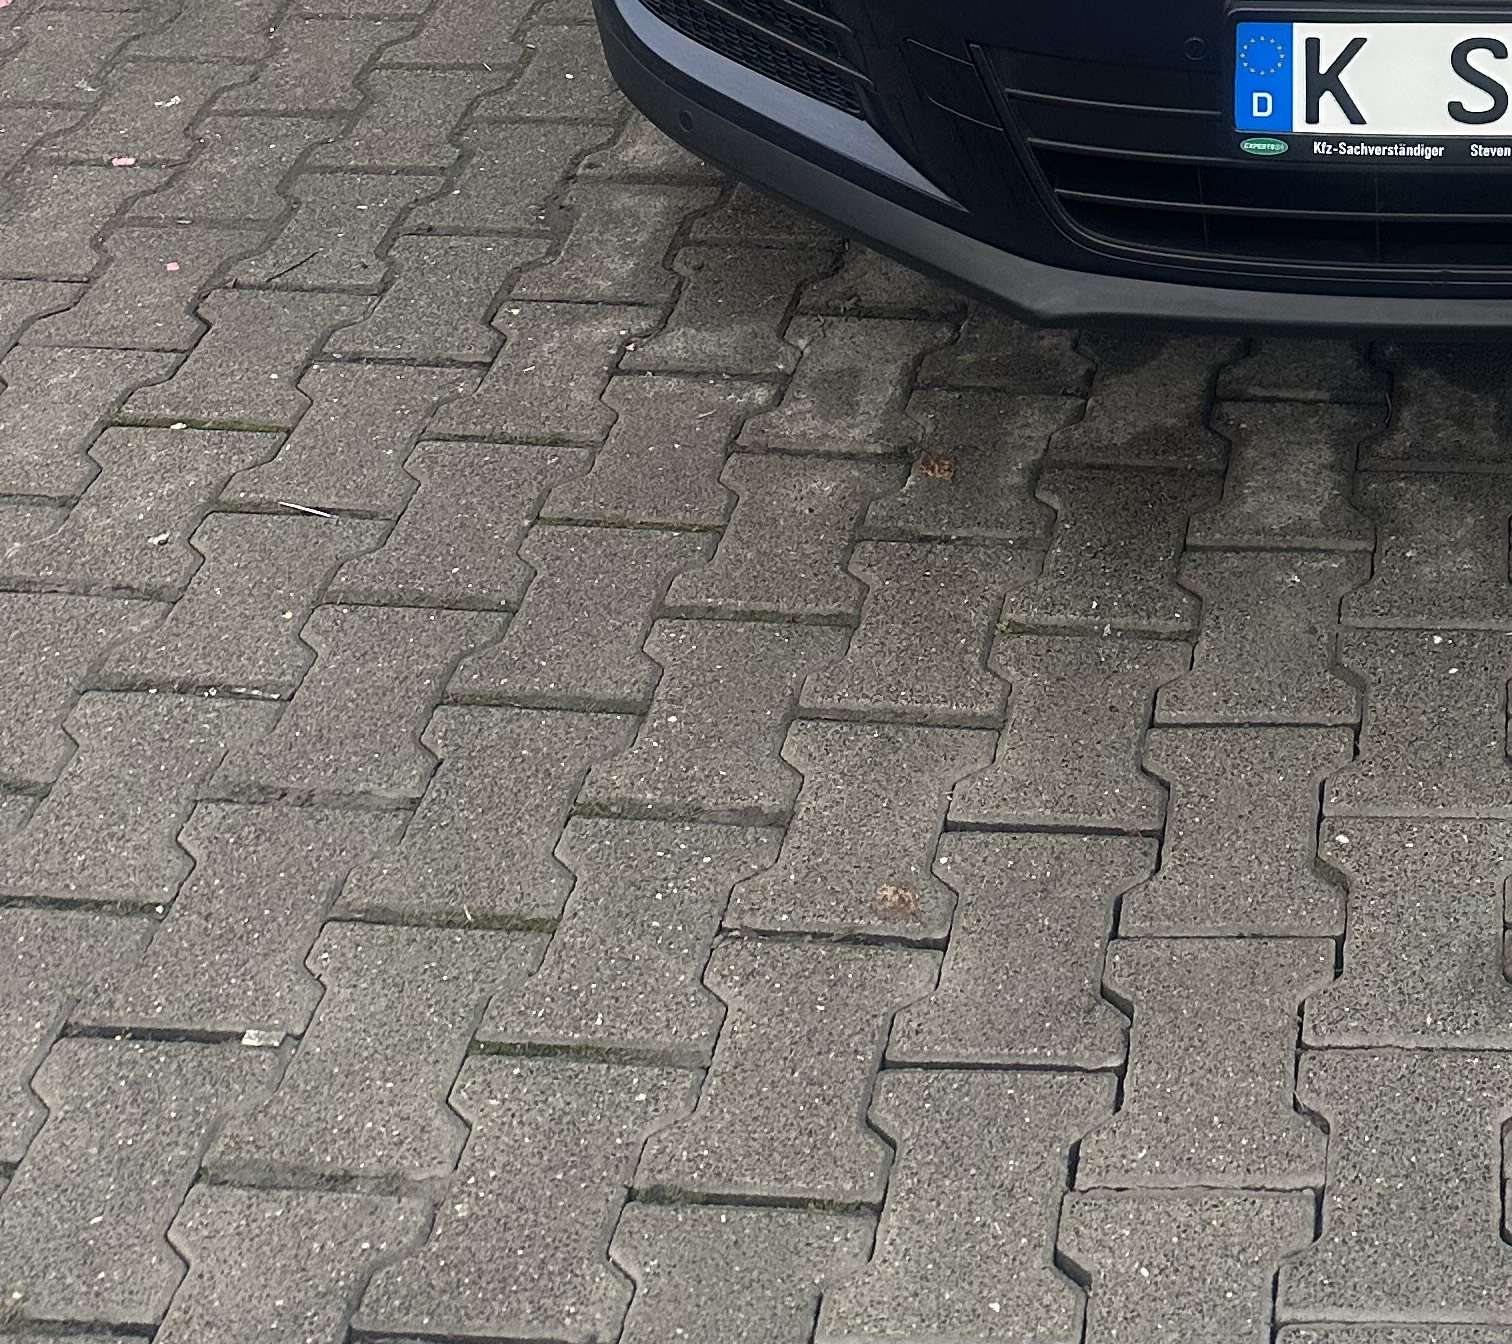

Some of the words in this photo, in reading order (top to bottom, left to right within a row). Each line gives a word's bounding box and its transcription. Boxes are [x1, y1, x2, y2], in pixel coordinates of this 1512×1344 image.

[1305, 36, 1367, 125] K
[1252, 91, 1273, 118] D
[1313, 141, 1445, 160] Kfz-Sachverständiger
[1470, 143, 1511, 157] Steven
